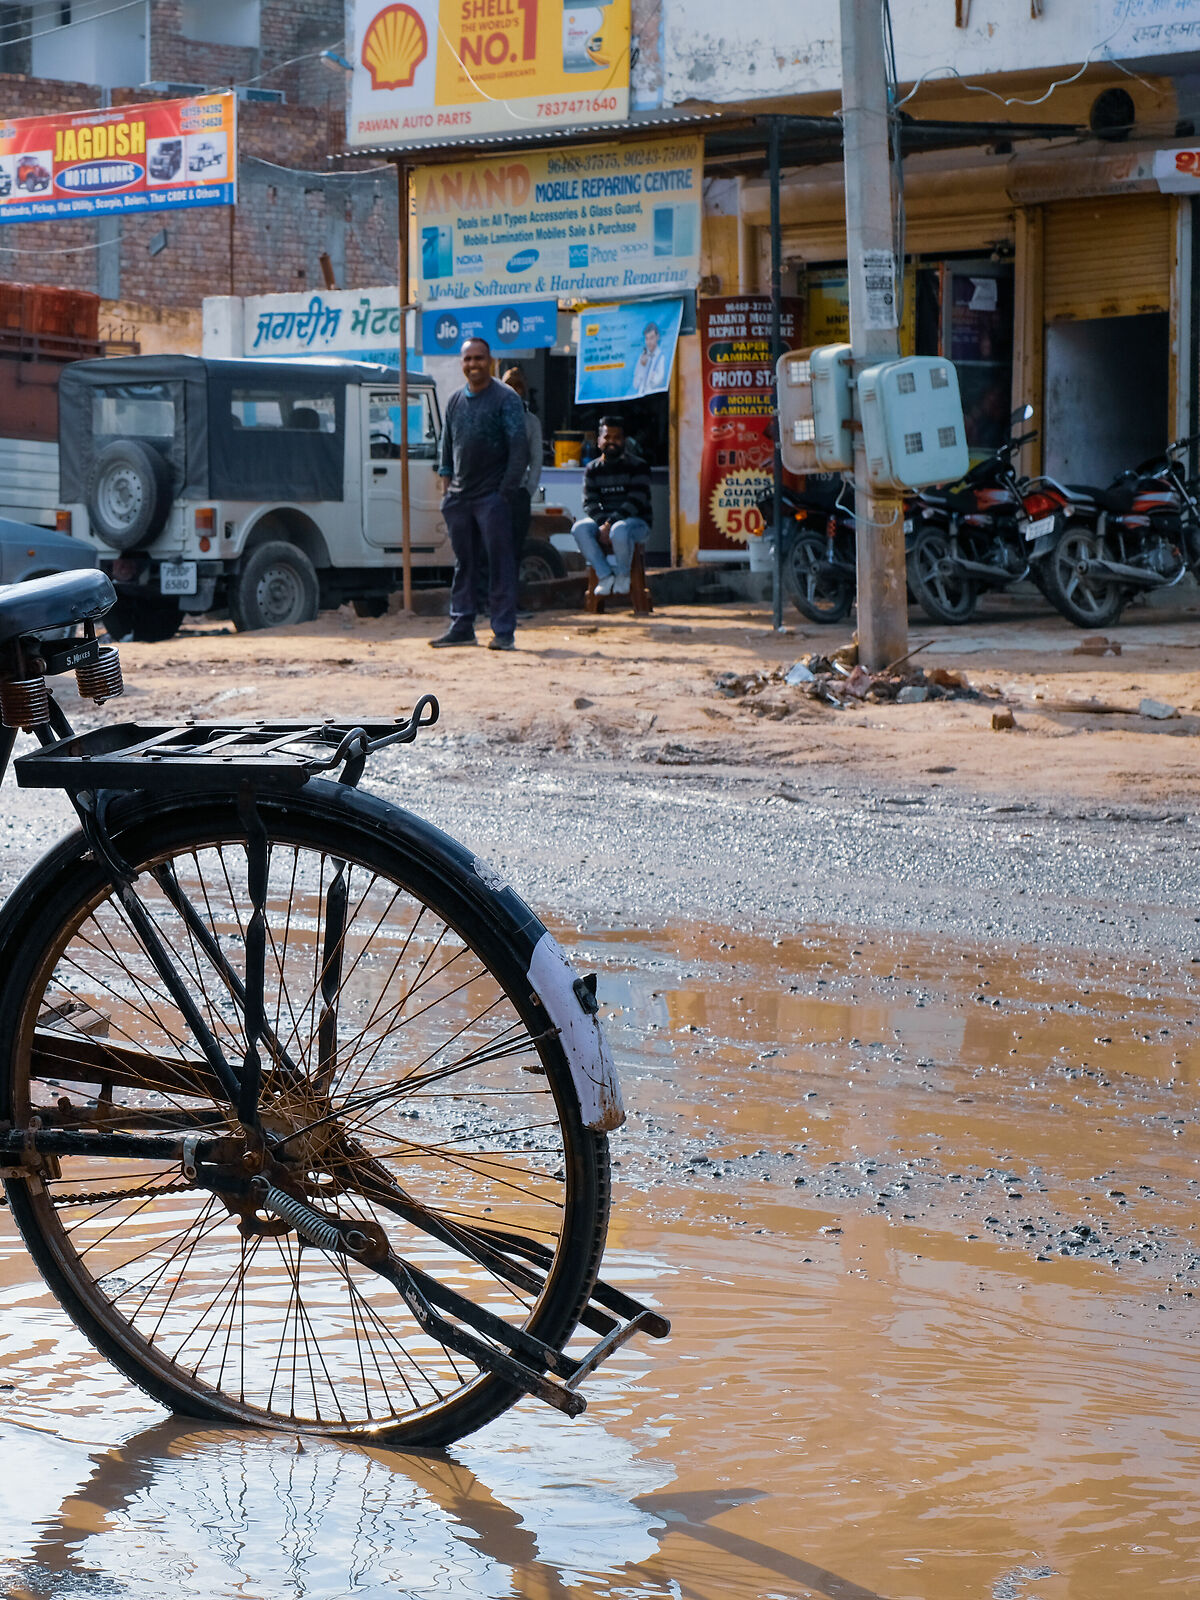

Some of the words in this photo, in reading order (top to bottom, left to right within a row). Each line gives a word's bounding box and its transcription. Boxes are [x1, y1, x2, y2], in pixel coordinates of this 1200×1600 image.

[461, 0, 514, 20] SHELL
[461, 23, 477, 33] THE
[479, 17, 519, 31] WORLD'S
[459, 31, 518, 68] NO.
[537, 96, 618, 118] 7837471640
[358, 118, 399, 134] PAWAN
[401, 114, 434, 130] AUTO
[437, 111, 472, 127] PARTS
[54, 121, 146, 162] JAGDISH
[64, 168, 100, 187] MOTOR
[100, 163, 135, 185] WORKS
[422, 163, 531, 216] ANAND
[535, 180, 579, 203] MOBILE
[582, 173, 641, 199] REPARING
[644, 168, 693, 192] CENTRE
[457, 217, 478, 230] Deals
[492, 214, 502, 226] All
[504, 212, 527, 228] Types
[529, 208, 579, 223] Accessories
[581, 206, 587, 218] &
[589, 204, 613, 217] Glass
[615, 201, 643, 216] Guard,
[463, 233, 489, 246] Mobile
[491, 231, 534, 244] Lamination
[536, 225, 566, 240] Mobiles
[568, 224, 587, 238] Sale
[589, 223, 595, 236] &
[598, 221, 637, 236] Purchase
[456, 254, 483, 265] NOKIA
[473, 279, 532, 298] Software
[535, 276, 546, 293] &
[550, 272, 619, 293] Hardware
[725, 302, 773, 312] 96468-3757
[498, 316, 520, 334] Jio
[709, 313, 745, 325] ANAND
[749, 313, 794, 325] MOBLE
[437, 321, 458, 340] Jio
[708, 326, 747, 338] REPAIR
[751, 325, 794, 337] CENRE
[733, 342, 769, 351] PAPER
[712, 371, 752, 387] PHOTO
[727, 396, 771, 405] MOBILE
[725, 478, 771, 487] GLASS
[719, 498, 740, 508] EAR
[726, 509, 761, 534] 50
